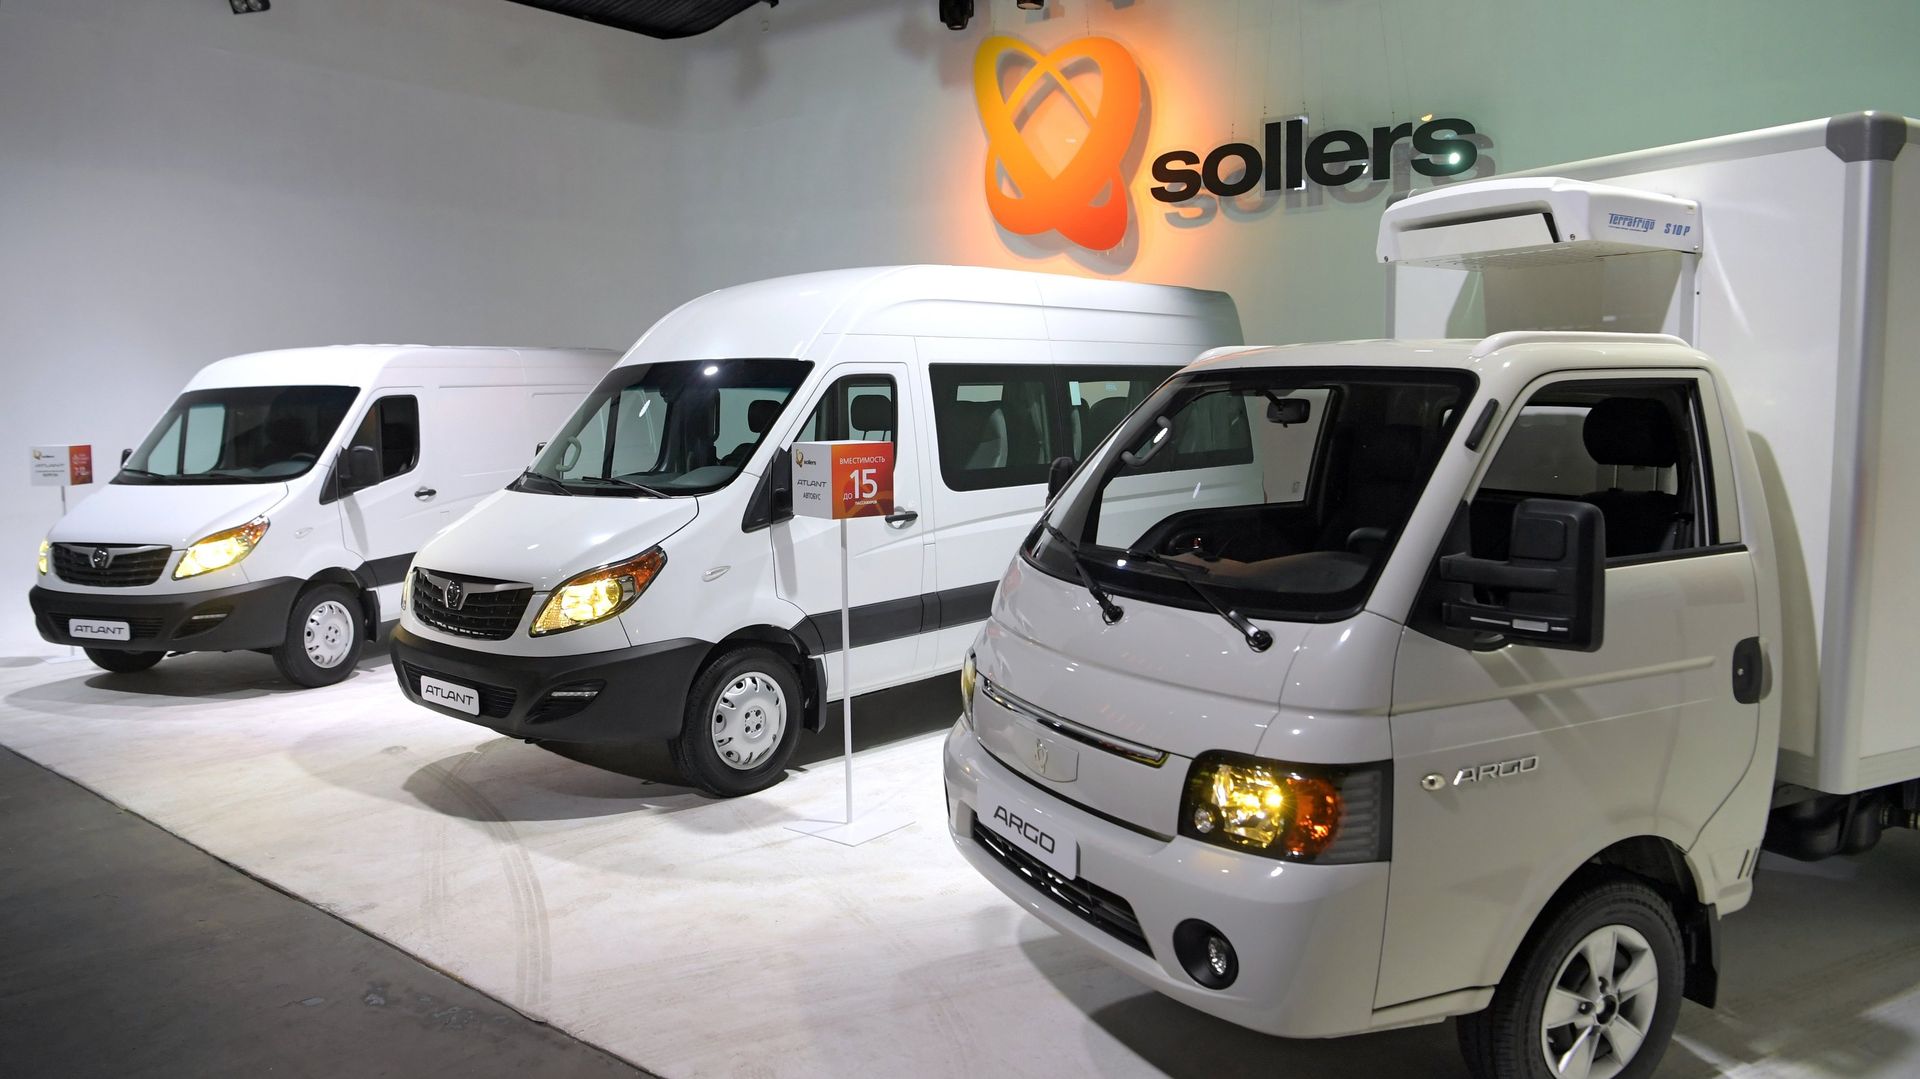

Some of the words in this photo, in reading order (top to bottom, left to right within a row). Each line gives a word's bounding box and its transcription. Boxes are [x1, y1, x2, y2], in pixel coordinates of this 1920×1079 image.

[1150, 117, 1478, 203] sollers
[839, 456, 886, 465] ВМЕСТИМОСТЬ
[797, 479, 827, 488] ATLANT
[843, 492, 853, 501] ДО
[849, 468, 878, 499] 15
[74, 624, 125, 634] ATLANT
[425, 684, 474, 705] ATLANT
[1453, 756, 1539, 786] ARGO
[993, 805, 1055, 854] ARGO
